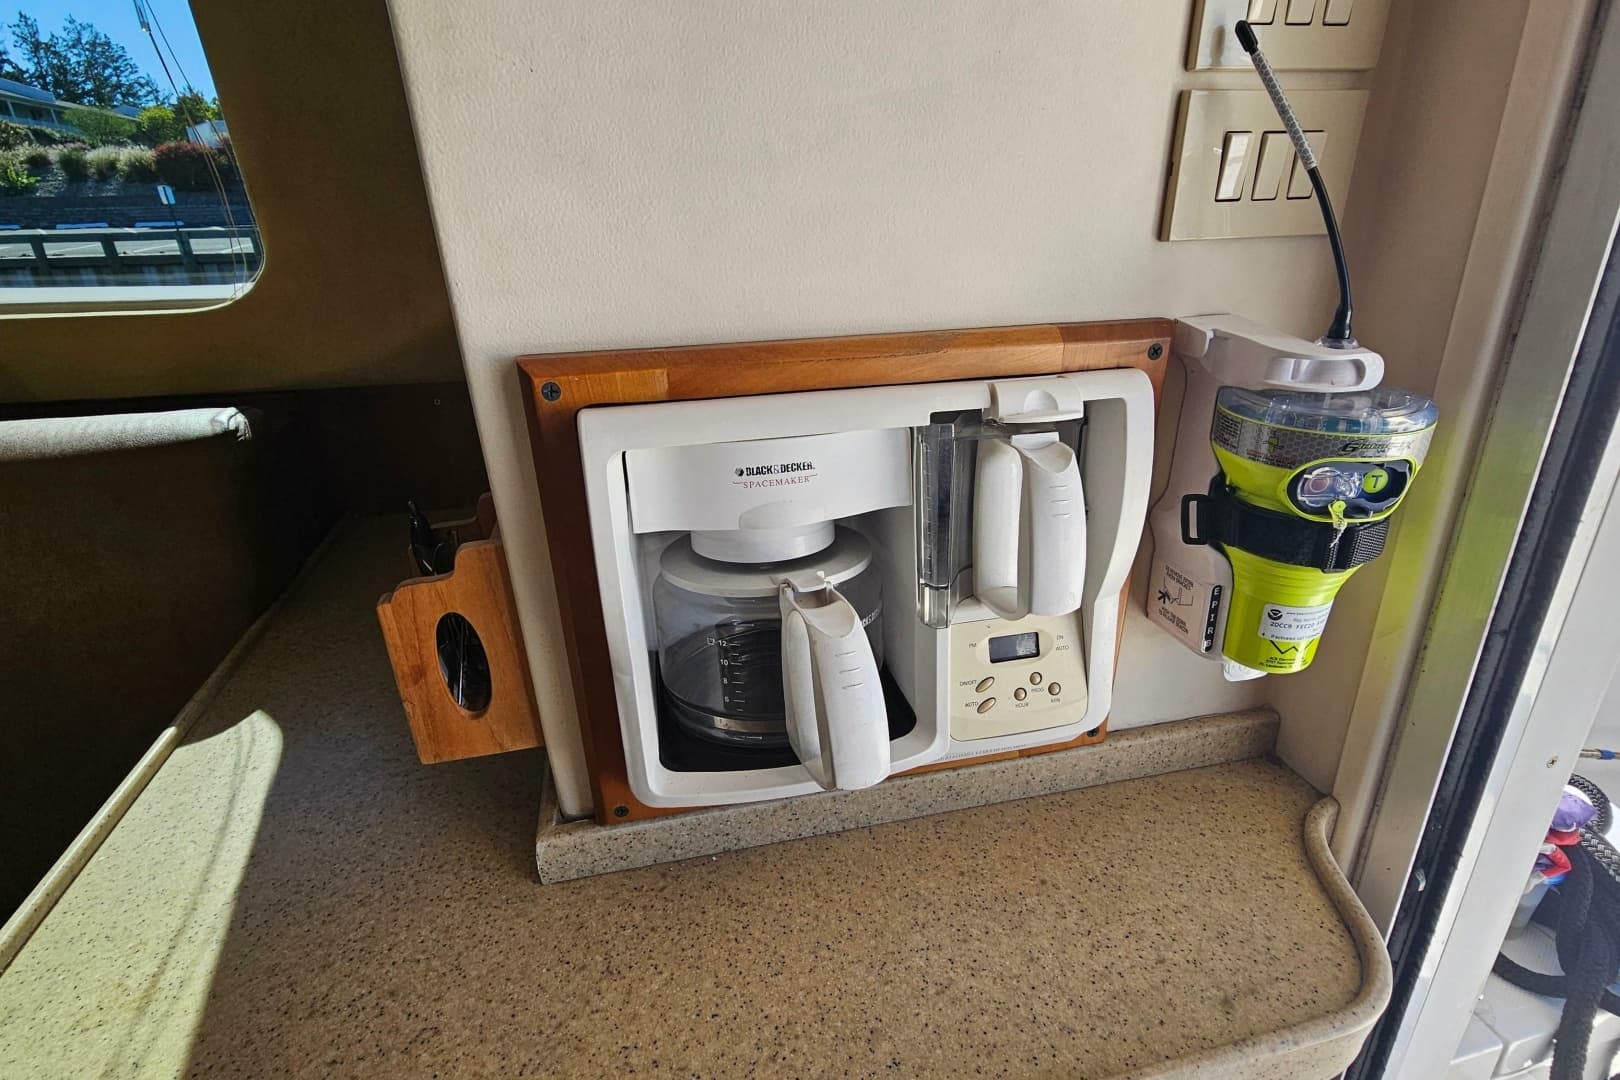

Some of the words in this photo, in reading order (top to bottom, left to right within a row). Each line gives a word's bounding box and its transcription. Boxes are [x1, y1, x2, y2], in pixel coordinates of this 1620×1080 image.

[743, 475, 810, 489] SPACEMAKER
[1371, 474, 1383, 489] T
[1204, 587, 1220, 647] EPIRB
[718, 639, 728, 647] 12
[1055, 644, 1070, 652] AUTO
